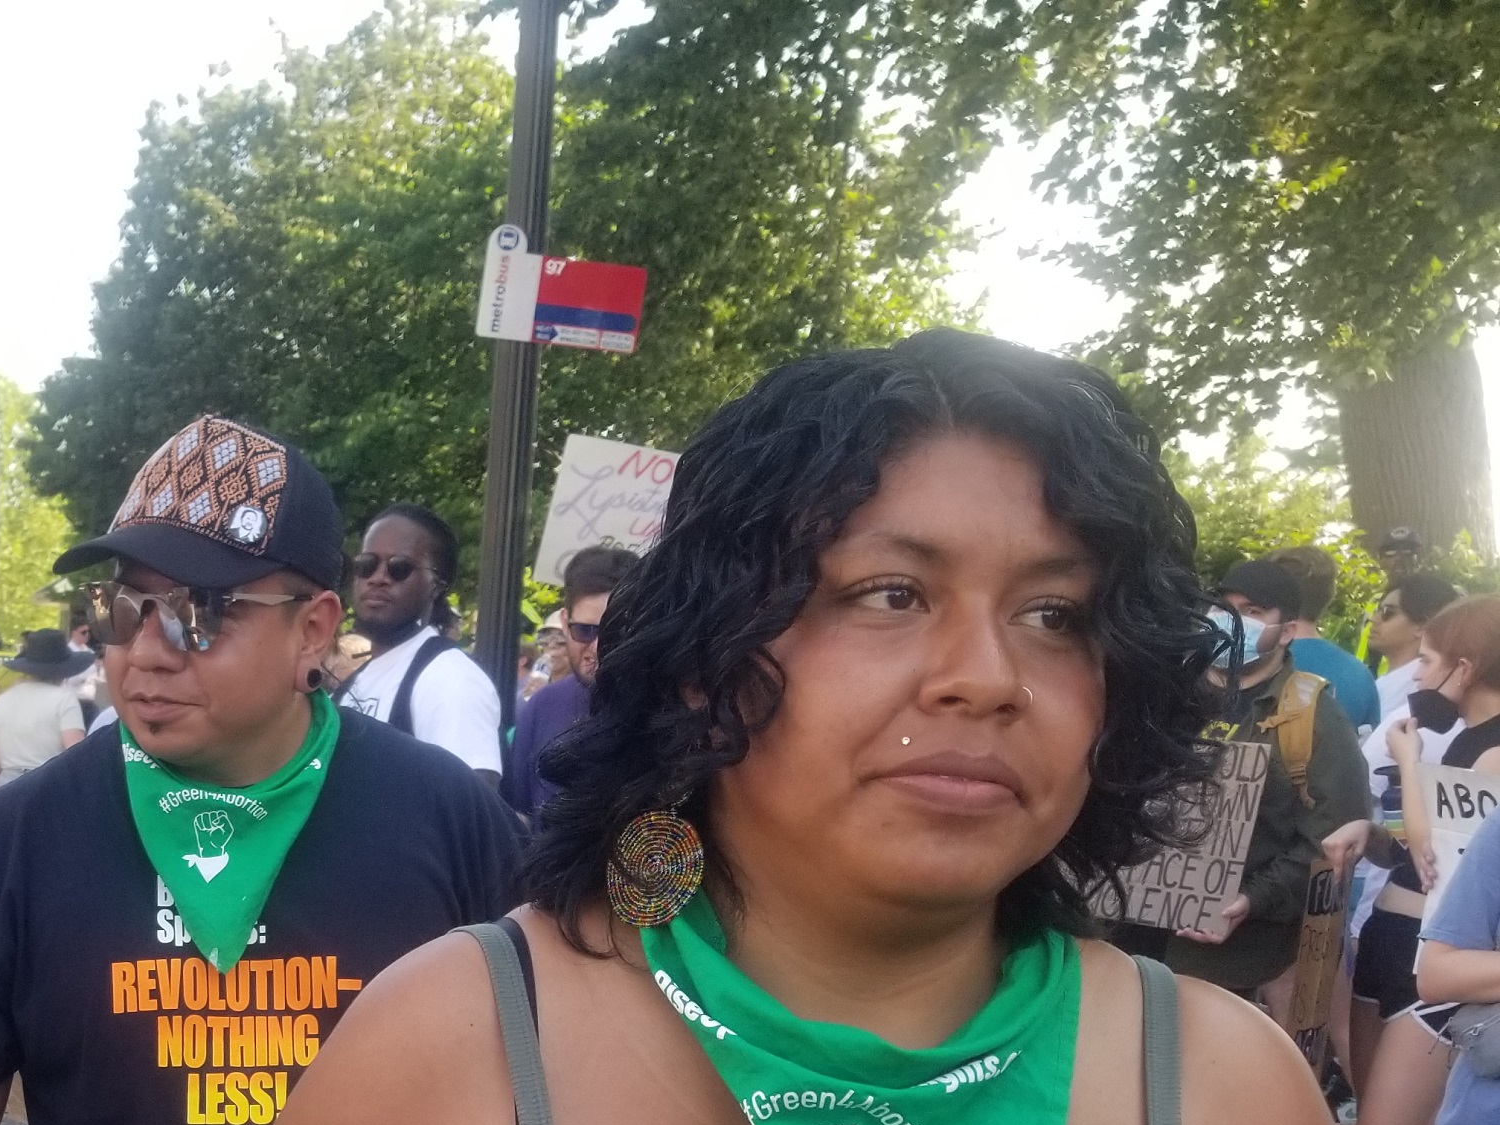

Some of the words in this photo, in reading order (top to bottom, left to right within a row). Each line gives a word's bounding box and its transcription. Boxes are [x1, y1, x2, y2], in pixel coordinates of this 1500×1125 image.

[490, 254, 510, 333] metrobus
[617, 449, 675, 484] NO
[1220, 744, 1269, 783] OLD
[1436, 780, 1499, 819] ABO
[1203, 858, 1245, 895] OF
[157, 1014, 320, 1068] NOTHING
[186, 1071, 289, 1125] LESS!
